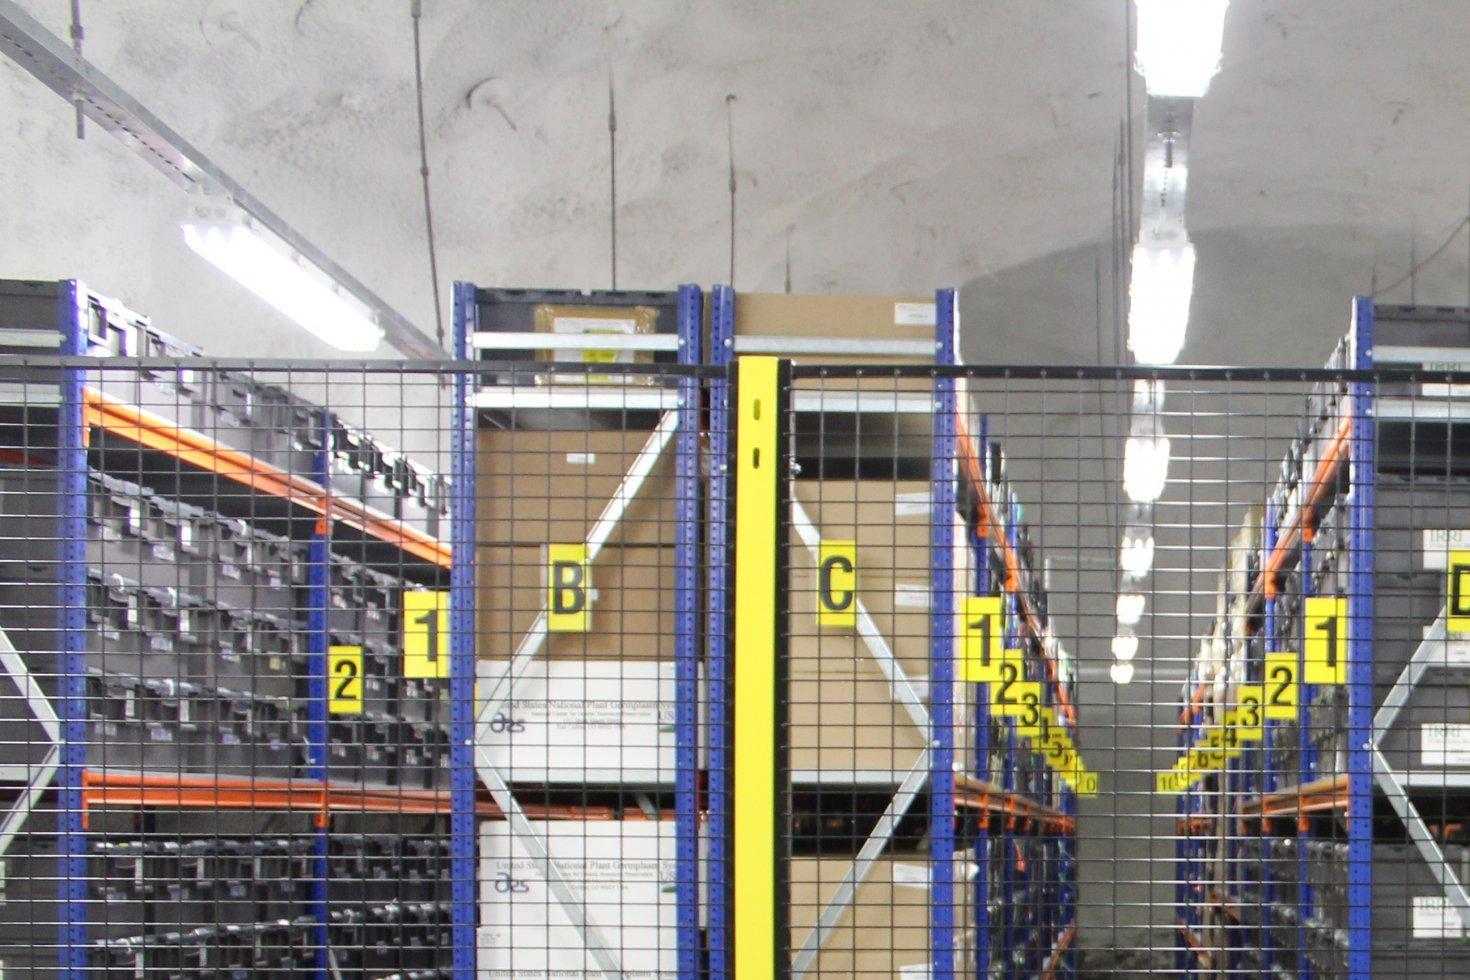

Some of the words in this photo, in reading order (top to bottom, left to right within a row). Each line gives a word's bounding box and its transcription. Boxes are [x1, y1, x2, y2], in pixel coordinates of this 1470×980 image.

[552, 561, 586, 615] B
[820, 556, 854, 610] C
[415, 609, 438, 662] 1
[968, 614, 991, 667] 1
[1315, 616, 1337, 667] 1
[335, 660, 357, 700] 2
[996, 663, 1018, 704] 2
[1271, 666, 1293, 706] 2
[1022, 693, 1039, 727] 3
[1241, 696, 1259, 727] 3
[1223, 721, 1237, 746] 4
